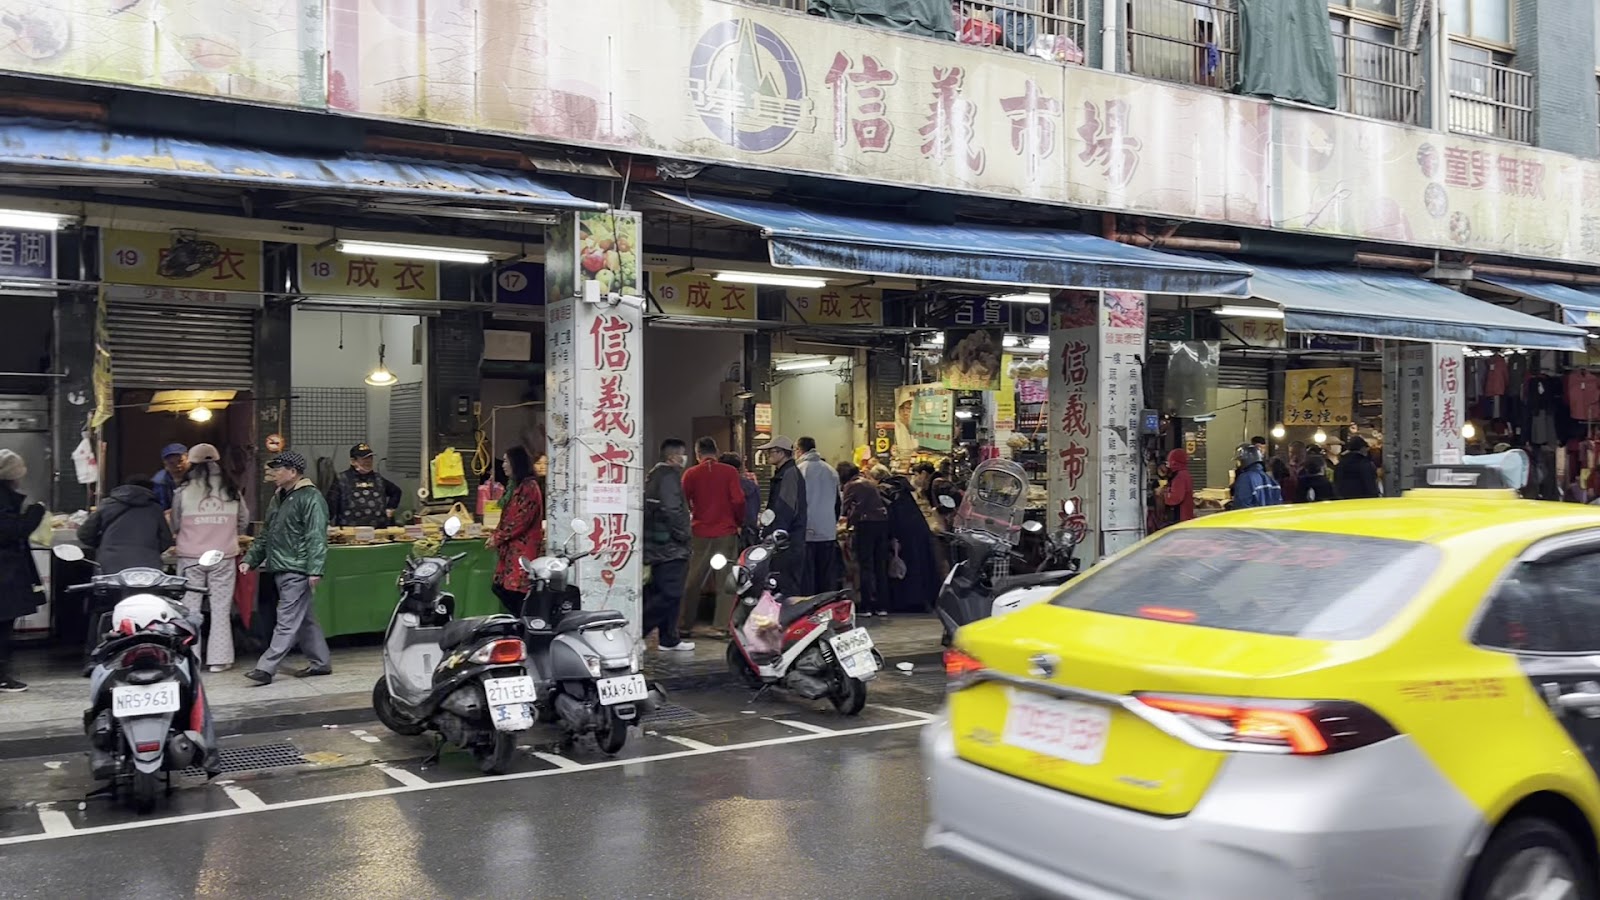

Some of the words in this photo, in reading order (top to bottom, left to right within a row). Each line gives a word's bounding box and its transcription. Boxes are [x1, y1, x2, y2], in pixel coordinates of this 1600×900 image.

[824, 51, 1142, 187] 信義市場
[116, 250, 138, 265] 19
[311, 262, 330, 276] 18
[346, 258, 425, 291] 成衣
[503, 274, 520, 288] 17
[659, 286, 674, 299] 16
[686, 281, 746, 311] 成衣
[818, 291, 872, 319] 成衣
[1242, 318, 1280, 342] 成衣
[587, 314, 635, 571] 信義市場
[1058, 340, 1090, 544] 信義市場
[193, 516, 229, 525] SMILEY
[601, 680, 644, 700] MXA-9617
